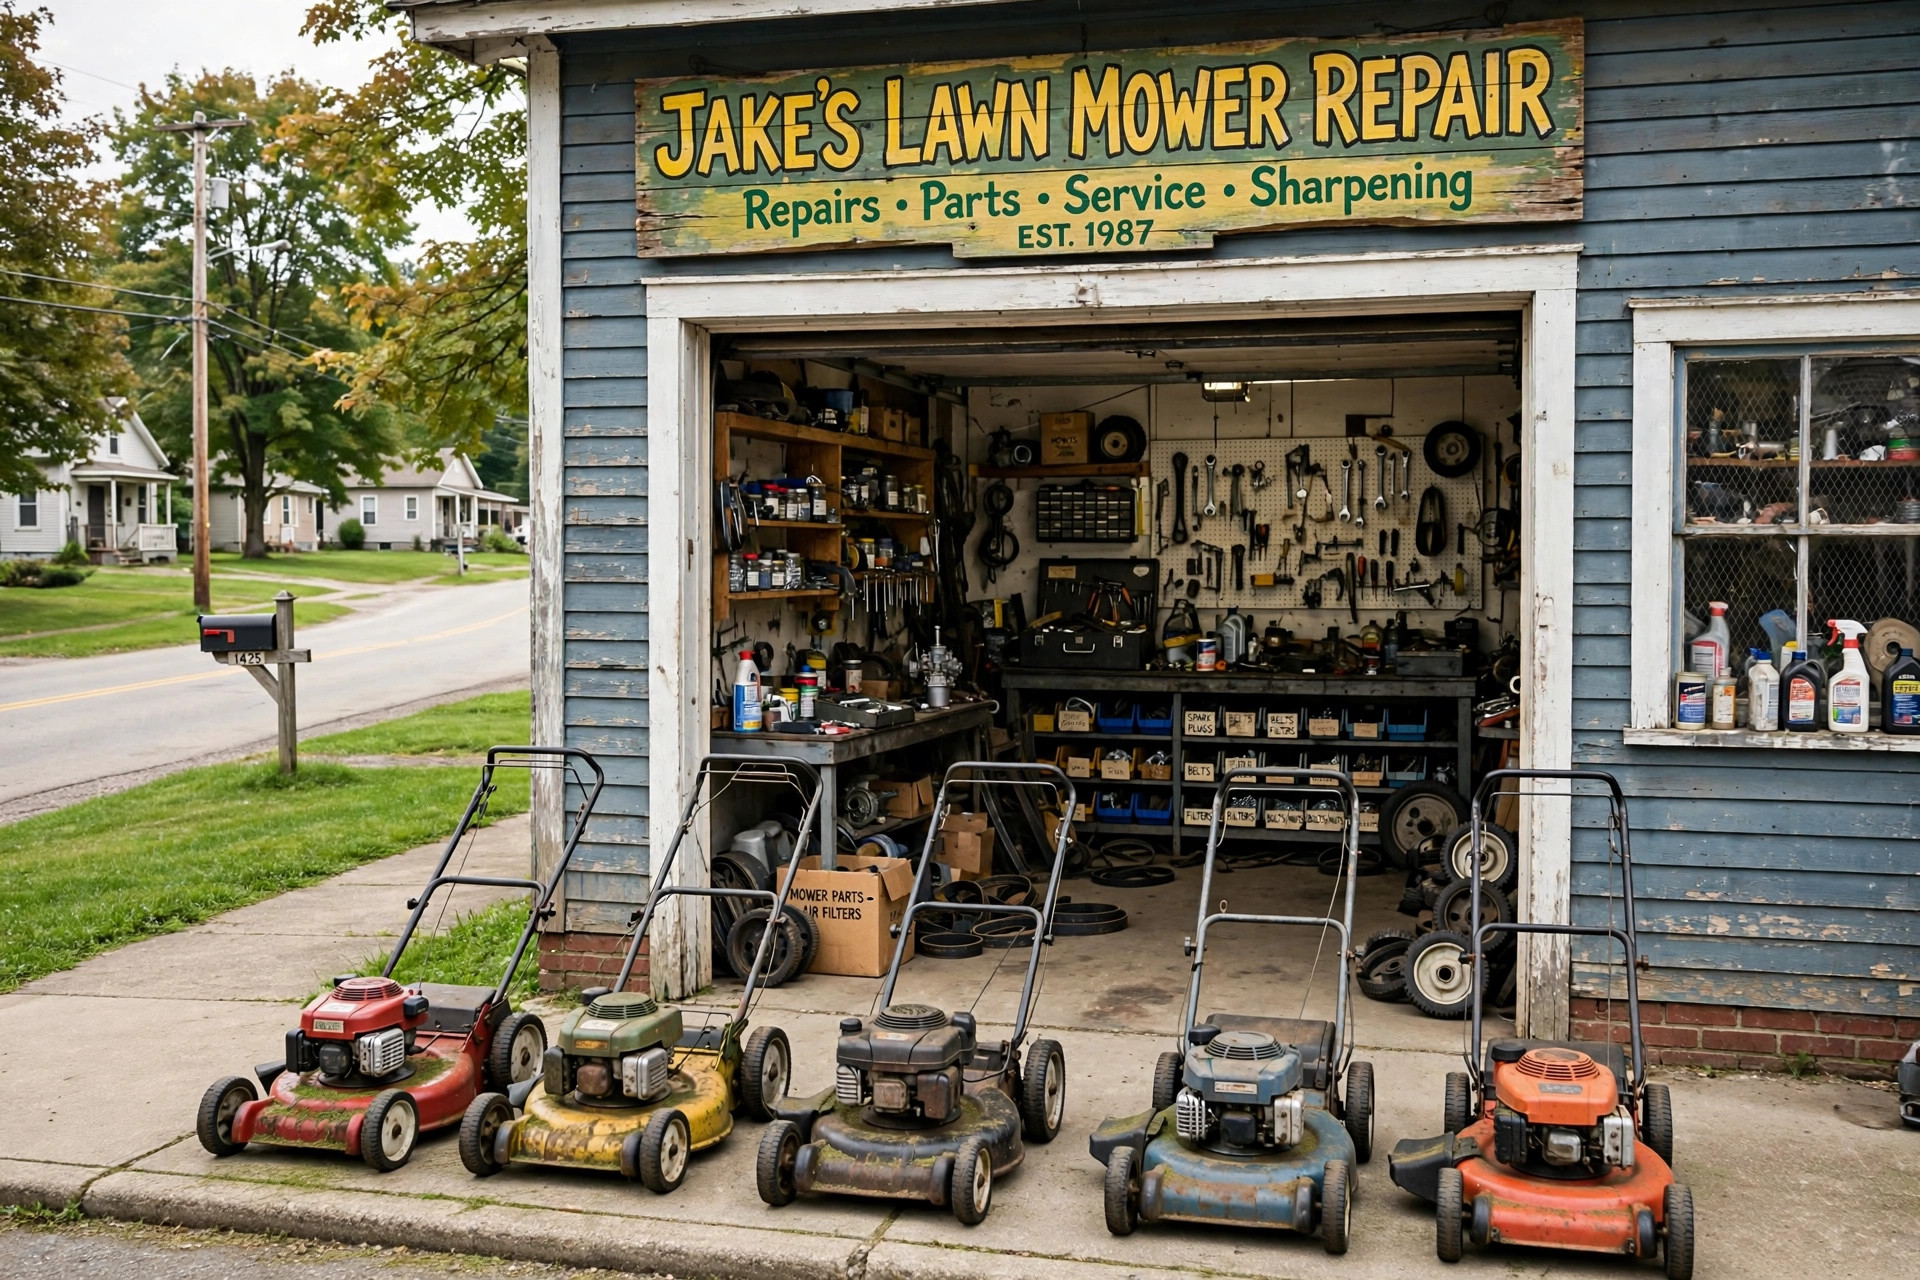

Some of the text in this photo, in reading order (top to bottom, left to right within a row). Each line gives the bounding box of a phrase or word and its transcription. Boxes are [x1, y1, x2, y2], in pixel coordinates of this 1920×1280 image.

[654, 44, 1556, 178] JAKE'S LAWN MOWER REPAIR
[743, 162, 1472, 238] Repairs Parts Service Sharpening
[1018, 219, 1155, 248] EST. 1987
[234, 652, 262, 664] 1425
[789, 888, 828, 901] MOWER
[832, 890, 864, 903] PARTS
[822, 906, 862, 920] FILTERS
